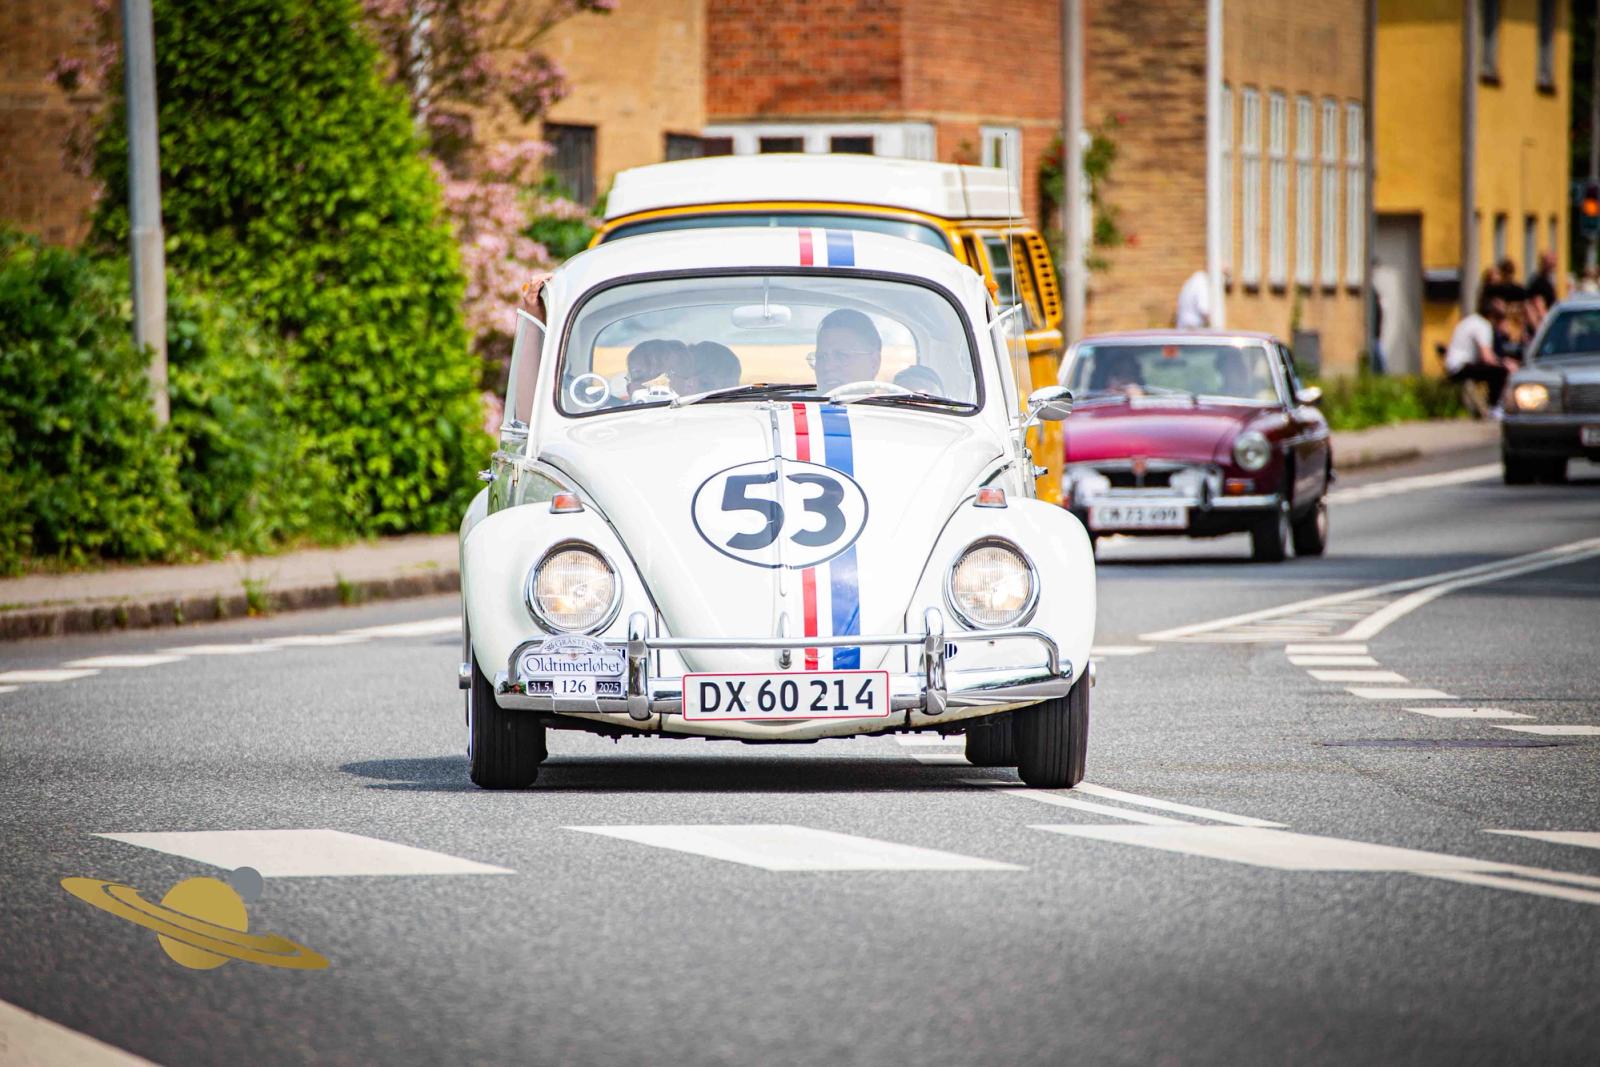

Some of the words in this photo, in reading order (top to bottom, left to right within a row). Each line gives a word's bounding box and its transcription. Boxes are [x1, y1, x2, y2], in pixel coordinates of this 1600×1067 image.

[721, 470, 846, 550] 53
[526, 657, 620, 673] Oldtimerløbet
[562, 680, 587, 693] 126
[599, 682, 619, 693] 2025
[700, 681, 746, 712] DX
[757, 679, 799, 712] 60
[810, 679, 873, 711] 214
